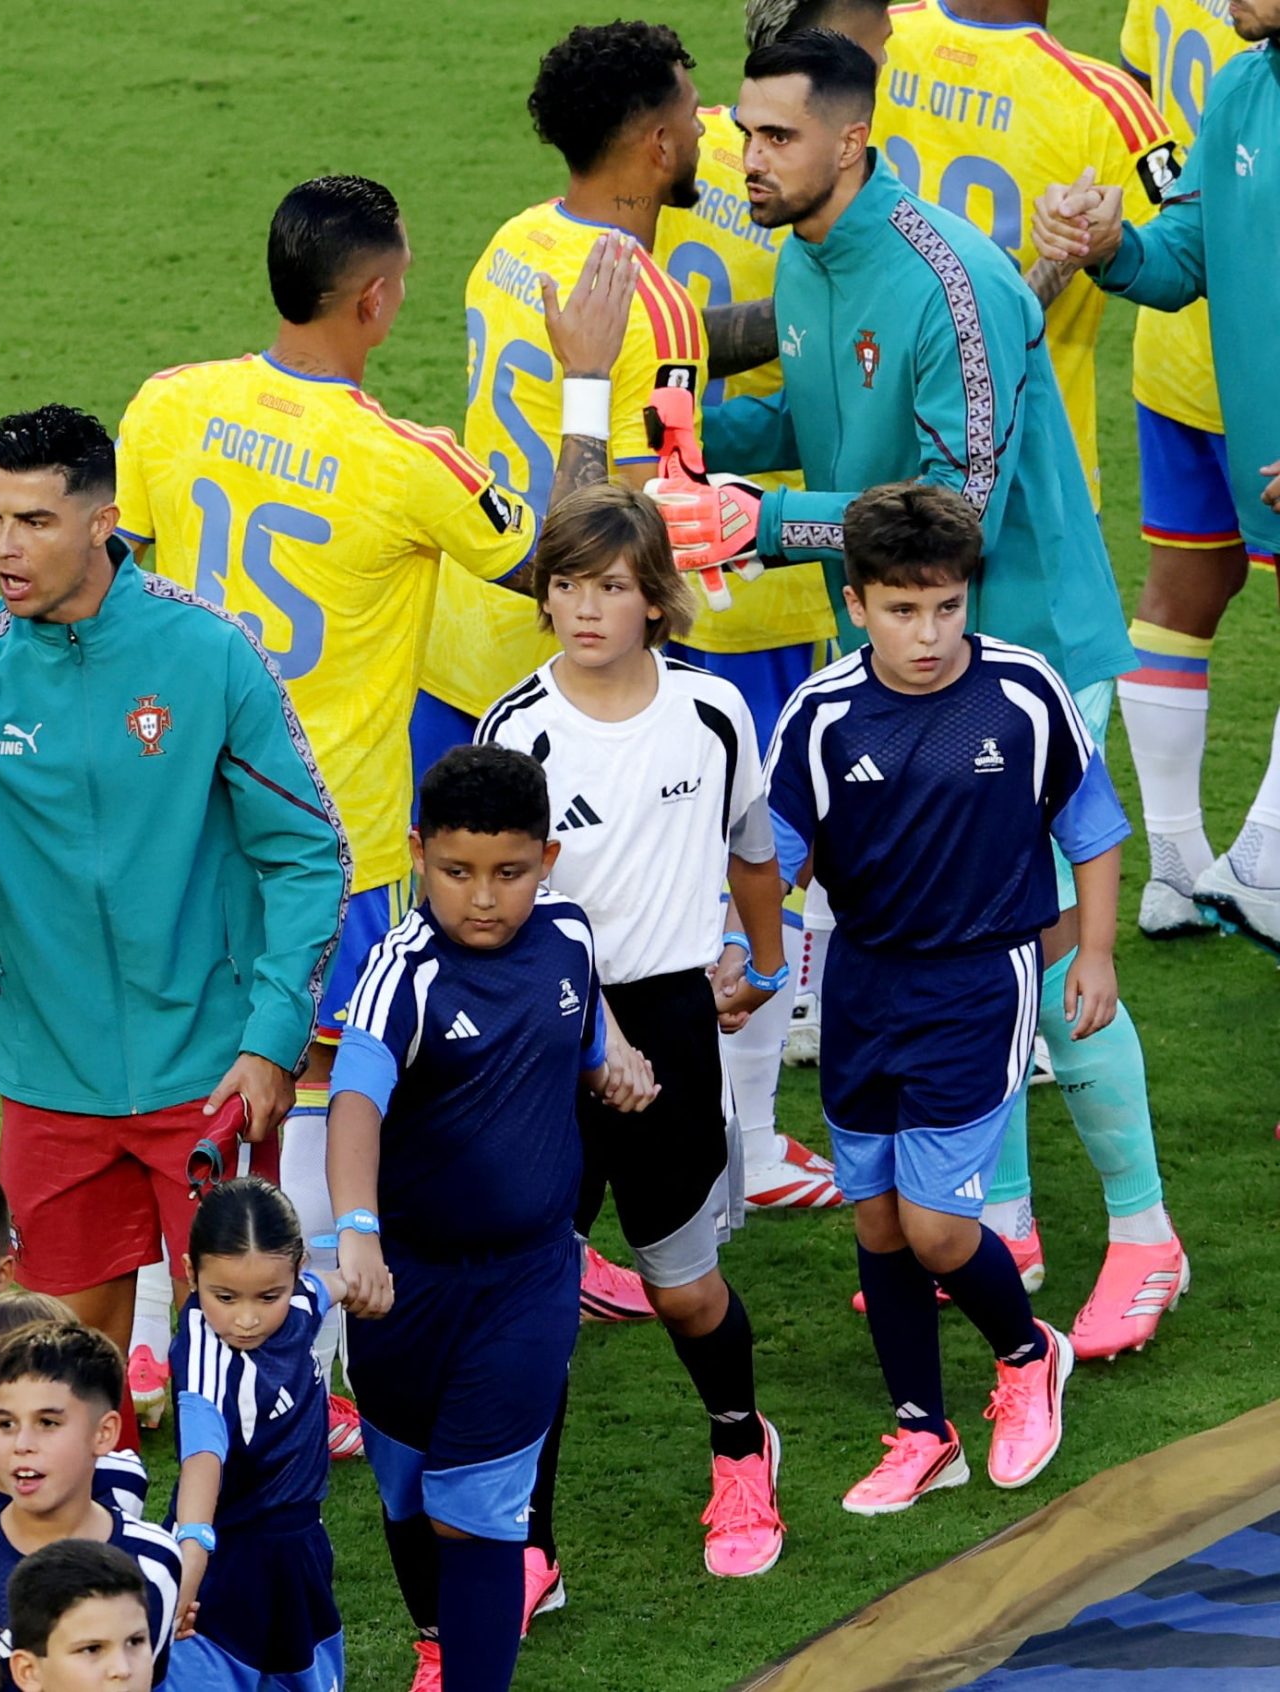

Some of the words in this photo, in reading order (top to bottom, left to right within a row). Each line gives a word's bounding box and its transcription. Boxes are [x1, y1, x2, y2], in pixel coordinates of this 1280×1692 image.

[889, 69, 1012, 131] W.DITTA
[202, 417, 339, 494] PORTILLA
[191, 477, 331, 681] 15
